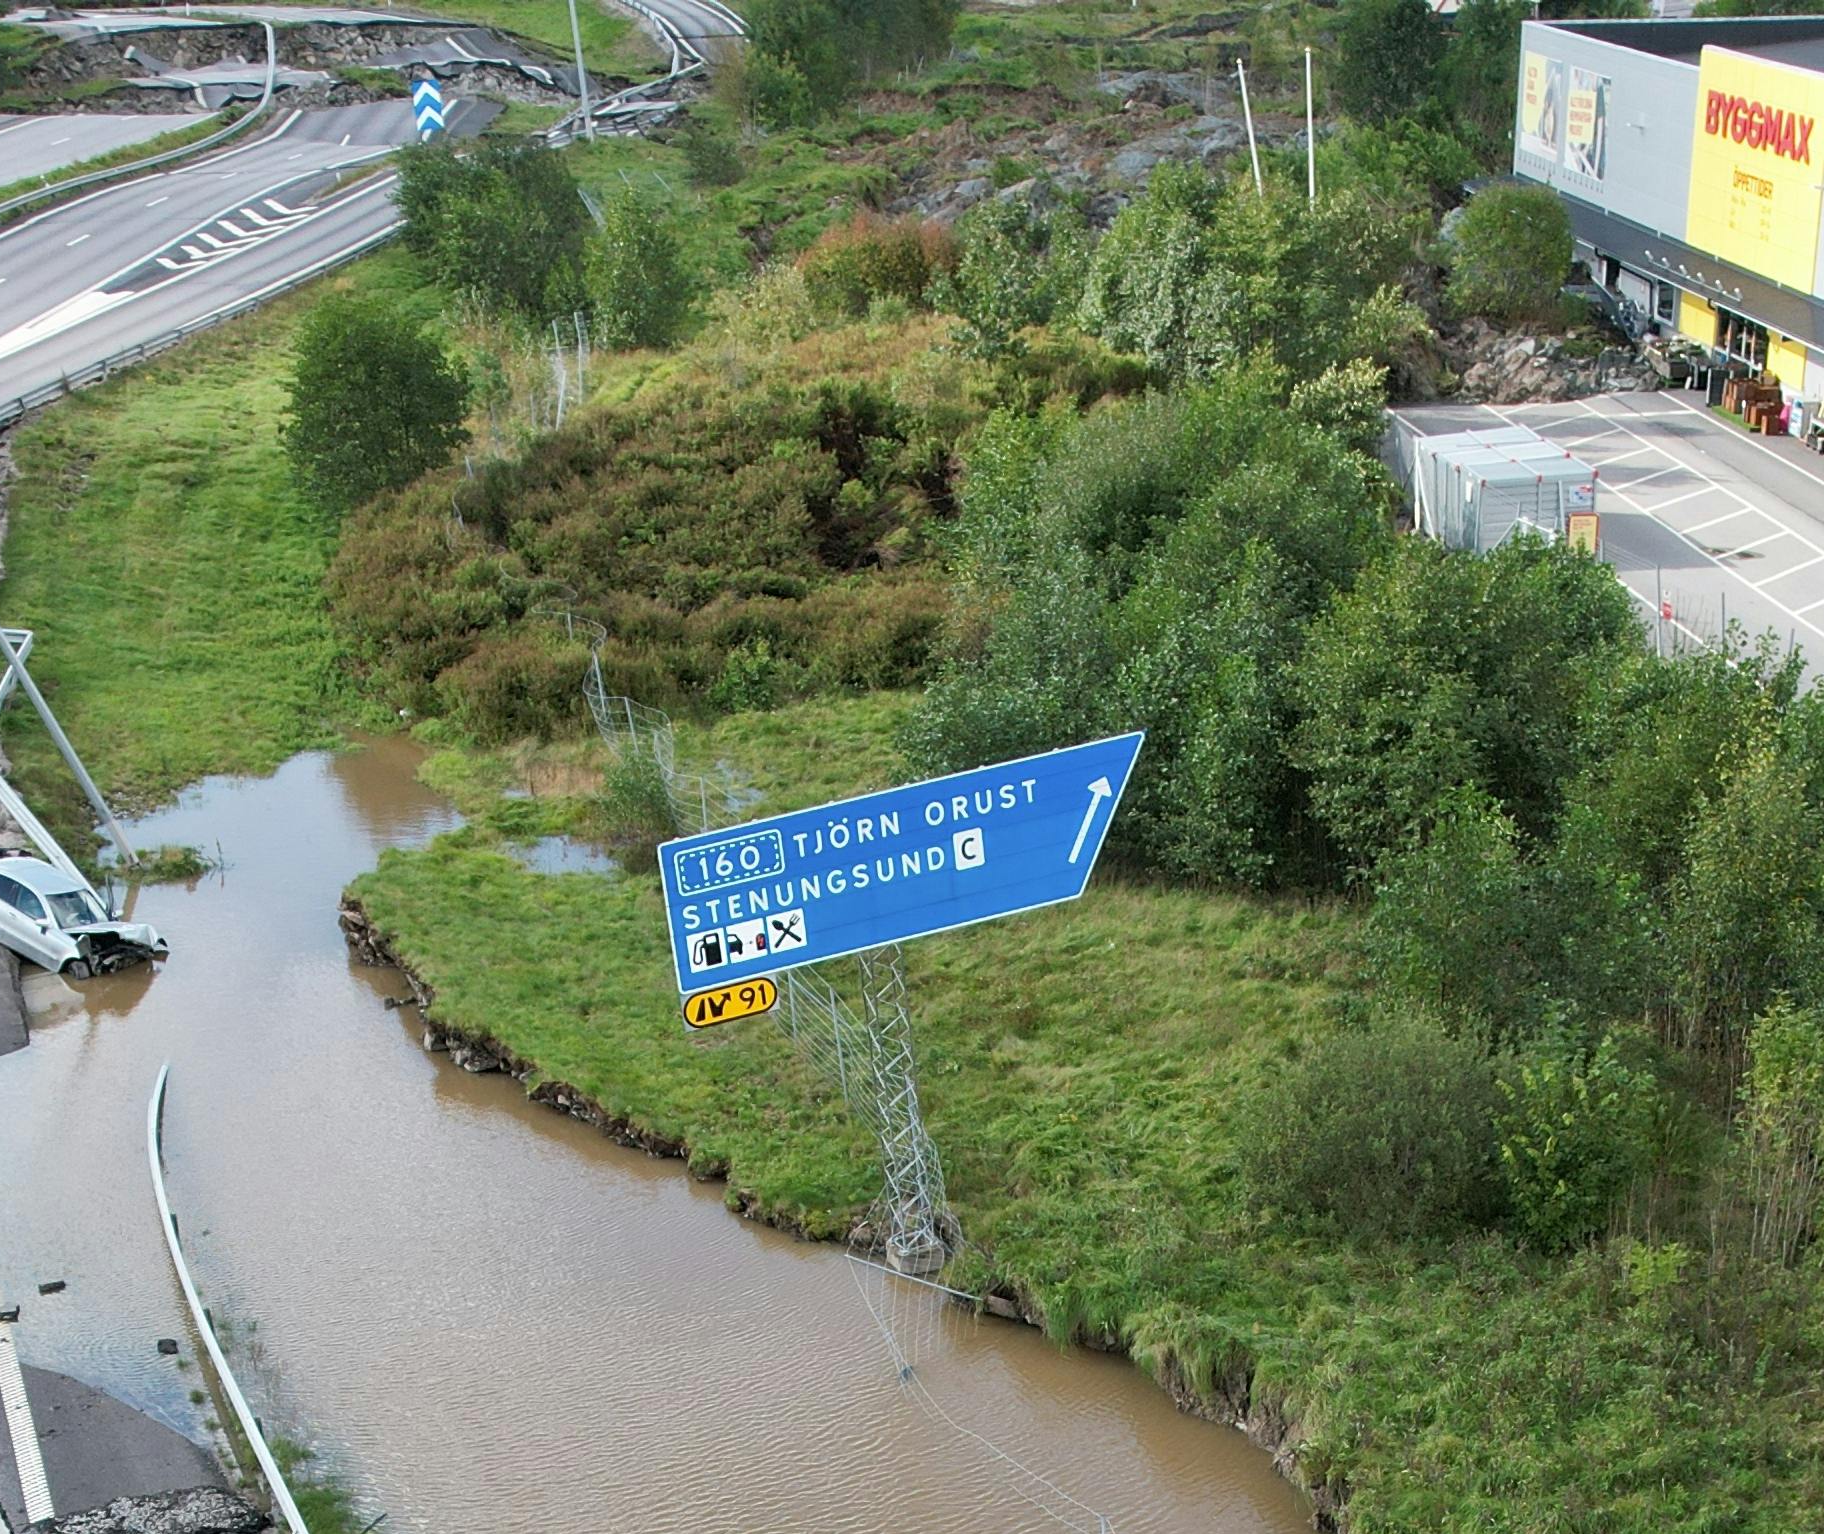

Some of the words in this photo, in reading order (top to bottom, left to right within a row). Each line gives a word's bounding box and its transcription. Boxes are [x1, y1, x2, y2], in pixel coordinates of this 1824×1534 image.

[1705, 89, 1814, 166] BYGGMAX
[698, 843, 761, 881] 160
[792, 811, 900, 857] TJÖRN
[924, 778, 1037, 825] ORUST
[681, 846, 946, 930] STENUNGSUND
[961, 837, 977, 861] C
[739, 983, 769, 1010] 91
